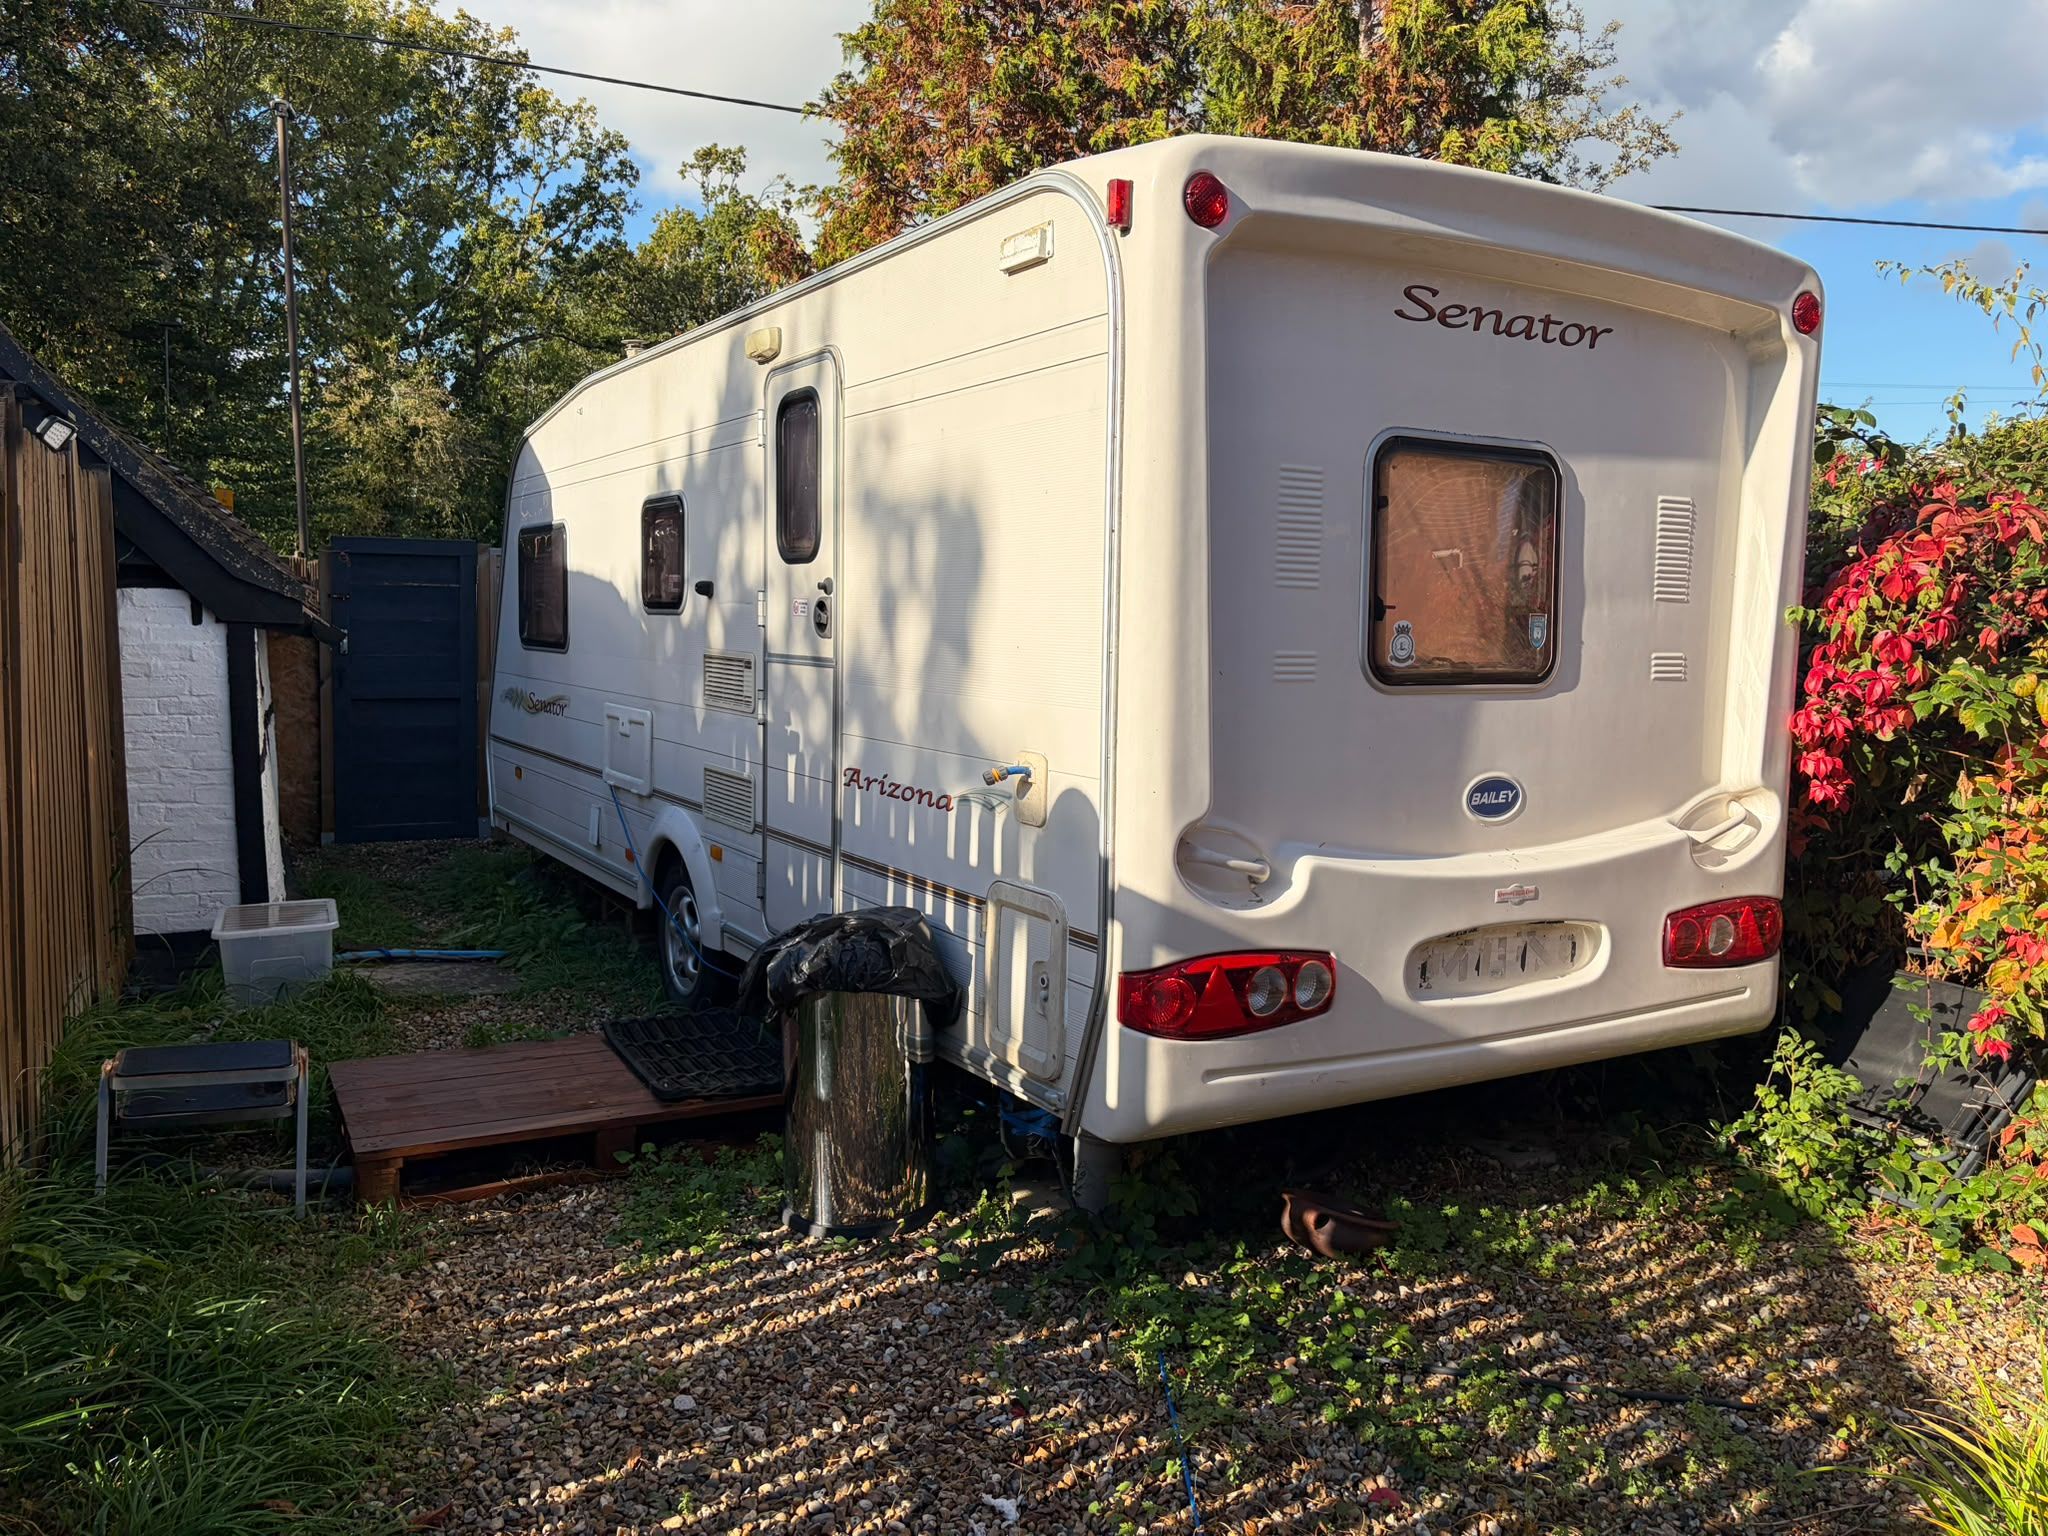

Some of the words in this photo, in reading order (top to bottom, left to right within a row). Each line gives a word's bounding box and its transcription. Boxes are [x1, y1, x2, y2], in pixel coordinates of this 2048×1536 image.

[1394, 284, 1614, 350] Senator
[527, 691, 568, 718] Senator
[843, 766, 954, 813] Arizona
[1471, 789, 1516, 806] BAILEY
